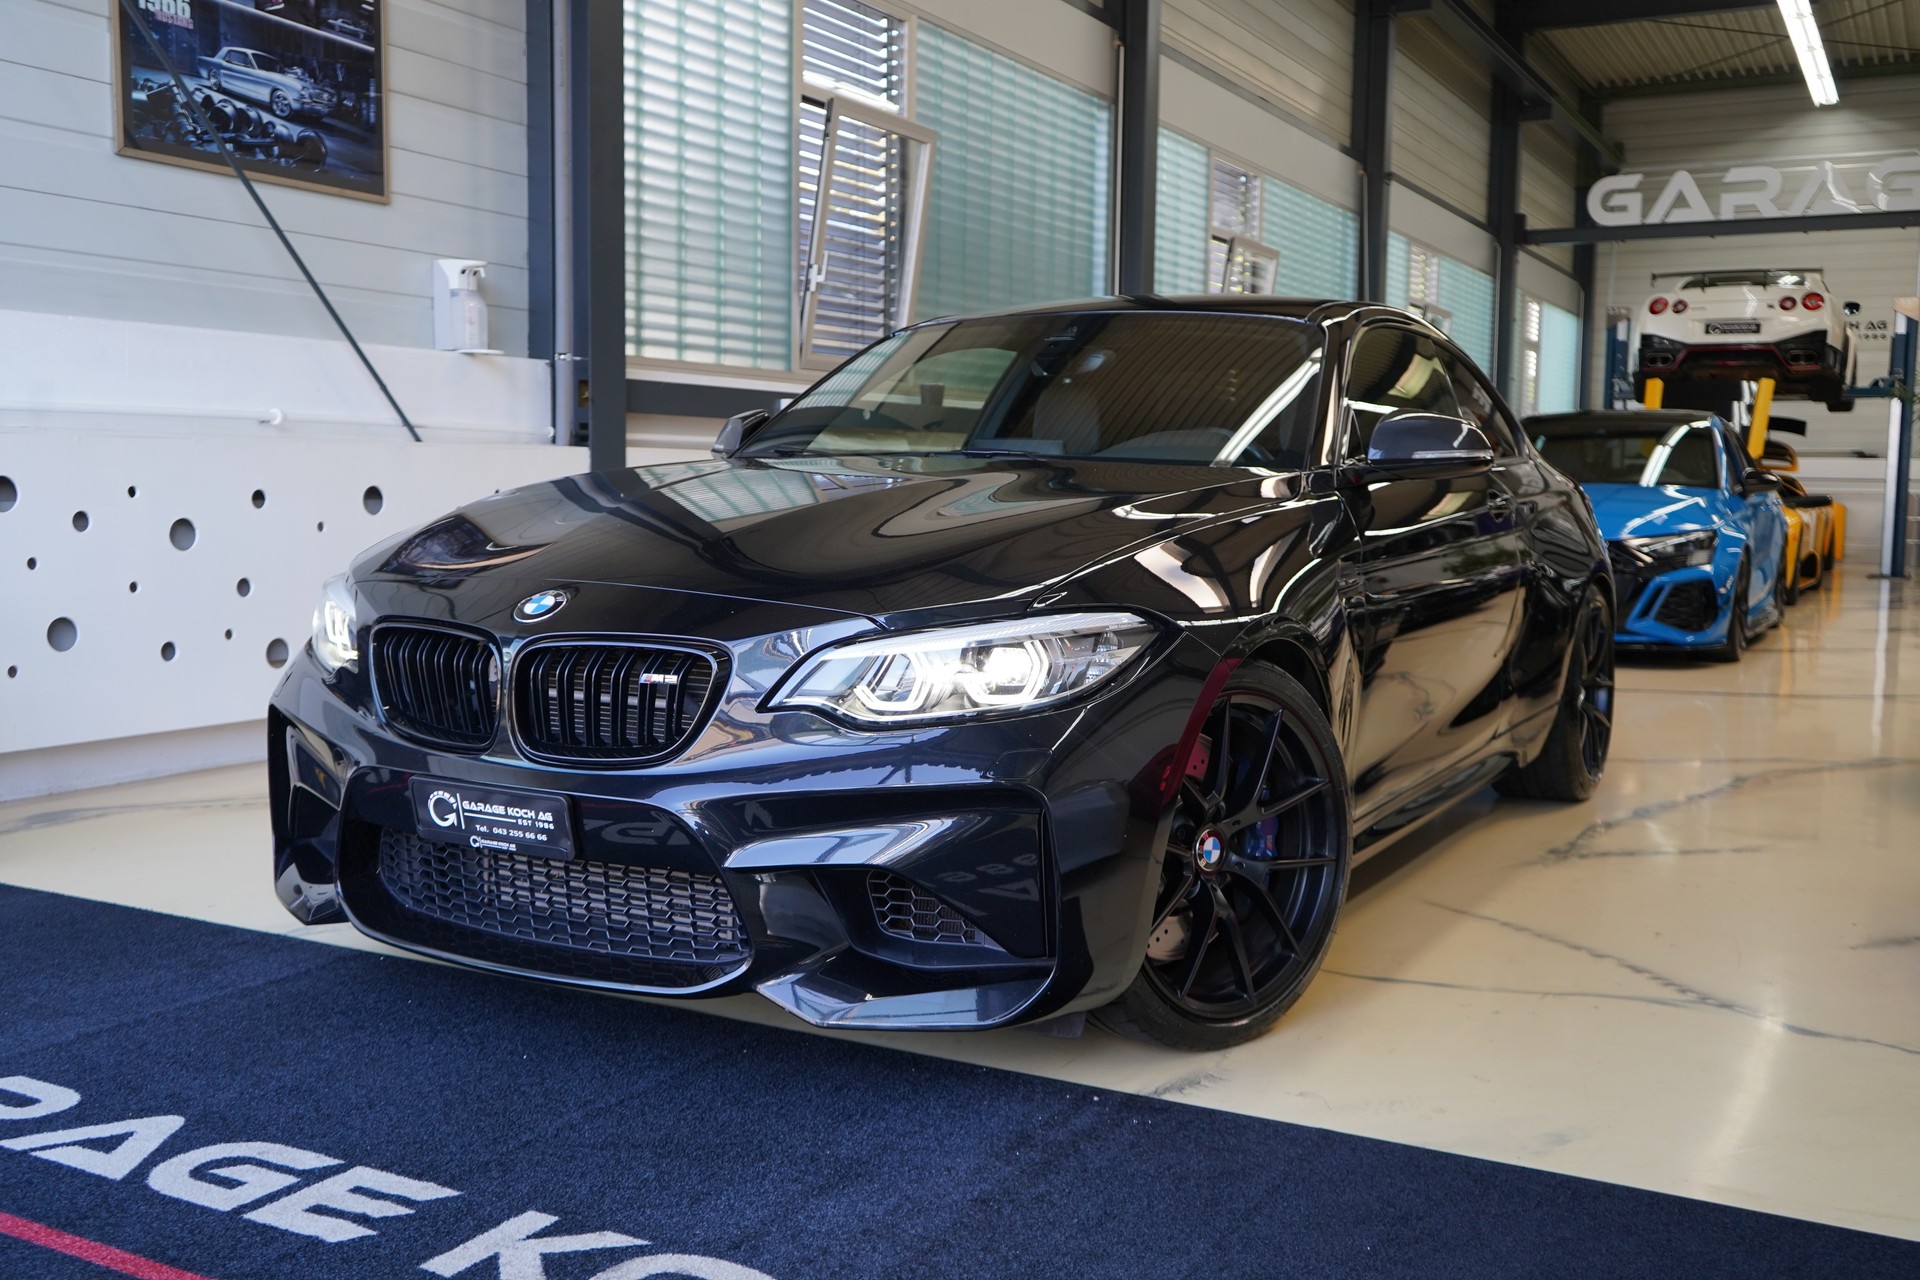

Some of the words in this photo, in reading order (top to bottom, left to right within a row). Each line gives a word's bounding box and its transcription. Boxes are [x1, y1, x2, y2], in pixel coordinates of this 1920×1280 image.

[1864, 320, 1888, 331] AG
[647, 673, 679, 684] M2
[462, 800, 506, 815] GARAGE
[507, 807, 535, 819] KOCH
[538, 811, 553, 822] AG
[518, 819, 532, 827] EST
[535, 821, 554, 830] 1986
[475, 824, 489, 833] Tel.
[493, 827, 507, 835] 043
[509, 829, 523, 838] 255
[525, 832, 535, 840] 66
[537, 833, 547, 841] 66
[419, 1210, 776, 1280] K
